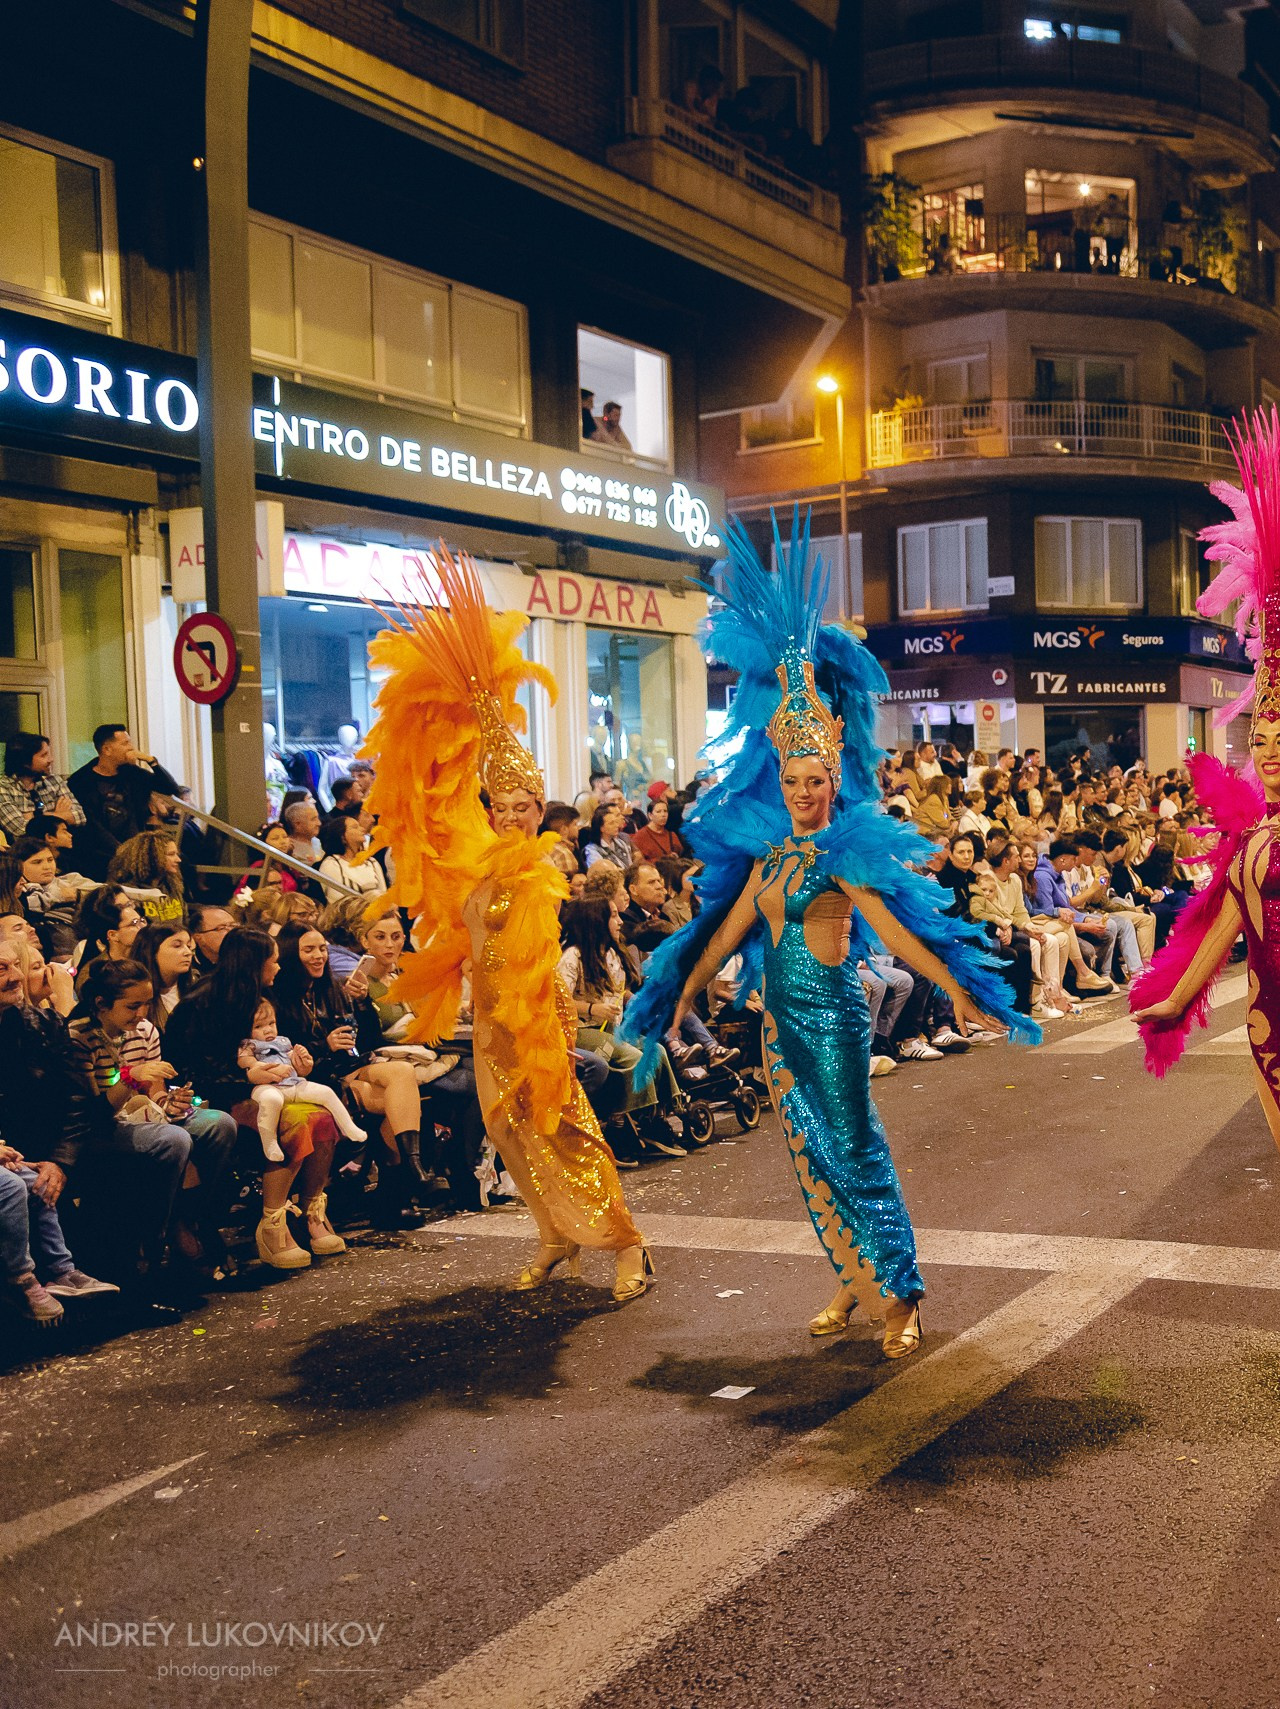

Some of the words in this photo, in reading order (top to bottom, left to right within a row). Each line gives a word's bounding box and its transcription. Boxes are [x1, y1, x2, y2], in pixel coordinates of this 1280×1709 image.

[0, 339, 199, 432] ORIO
[253, 408, 369, 461] ENTRO
[380, 435, 422, 473] DE
[431, 446, 553, 500] BELLEZA
[577, 495, 602, 517] 677
[606, 501, 631, 522] 725
[527, 574, 664, 627] ADARA
[904, 636, 944, 655] MGS
[1033, 631, 1081, 648] MGS
[1122, 633, 1164, 648] Seguros
[1203, 636, 1220, 654] MGS
[1031, 671, 1068, 694] TZ
[1077, 682, 1167, 694] FABRICANTES
